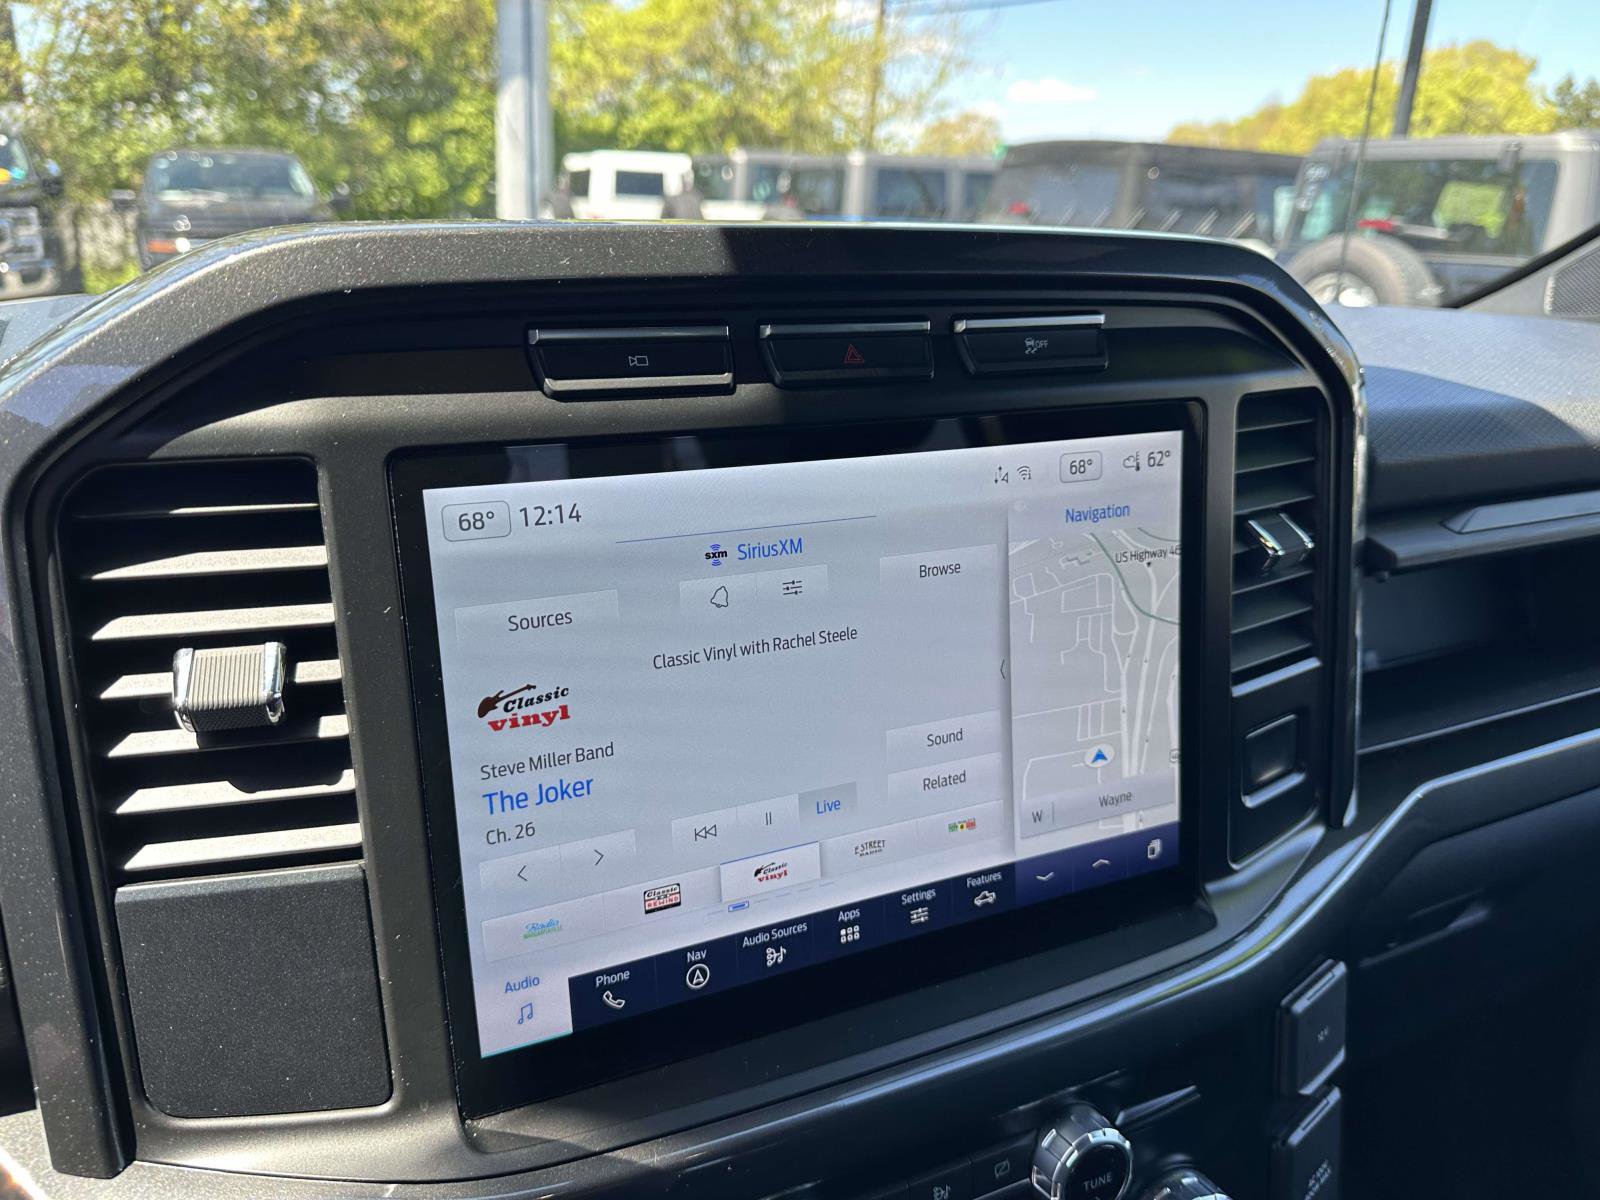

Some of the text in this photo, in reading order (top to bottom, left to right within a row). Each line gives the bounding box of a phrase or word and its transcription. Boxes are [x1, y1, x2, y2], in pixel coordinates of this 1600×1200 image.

[458, 511, 495, 531] 68°
[519, 503, 582, 528] 12:14
[1065, 504, 1130, 523] Navigation
[704, 549, 728, 560] sxm
[737, 537, 803, 561] SiriusXM
[1115, 551, 1128, 563] US
[1130, 547, 1168, 562] Highway
[919, 560, 961, 578] Browse
[508, 609, 573, 632] Sources
[653, 626, 858, 670] Classic Vinyl with Rachel Steele
[503, 685, 570, 713] Classic
[488, 704, 571, 732] vinyl
[927, 728, 963, 747] Sound
[480, 742, 615, 780] Steve Miller Band
[923, 769, 966, 791] Related
[482, 776, 595, 815] The Joker
[1099, 790, 1132, 808] Wayne
[816, 798, 841, 815] Live
[1031, 809, 1043, 823] W
[486, 822, 536, 846] Ch. 26
[860, 839, 886, 852] STREET
[966, 870, 1002, 888] Features
[647, 895, 679, 908] REWIND
[901, 887, 936, 905] Settings
[838, 907, 860, 923] Apps
[743, 921, 808, 948] Audio Sources
[687, 949, 707, 962] Nav
[505, 974, 540, 993] Audio
[596, 969, 630, 988] Phone
[1083, 1171, 1112, 1191] TUNE
